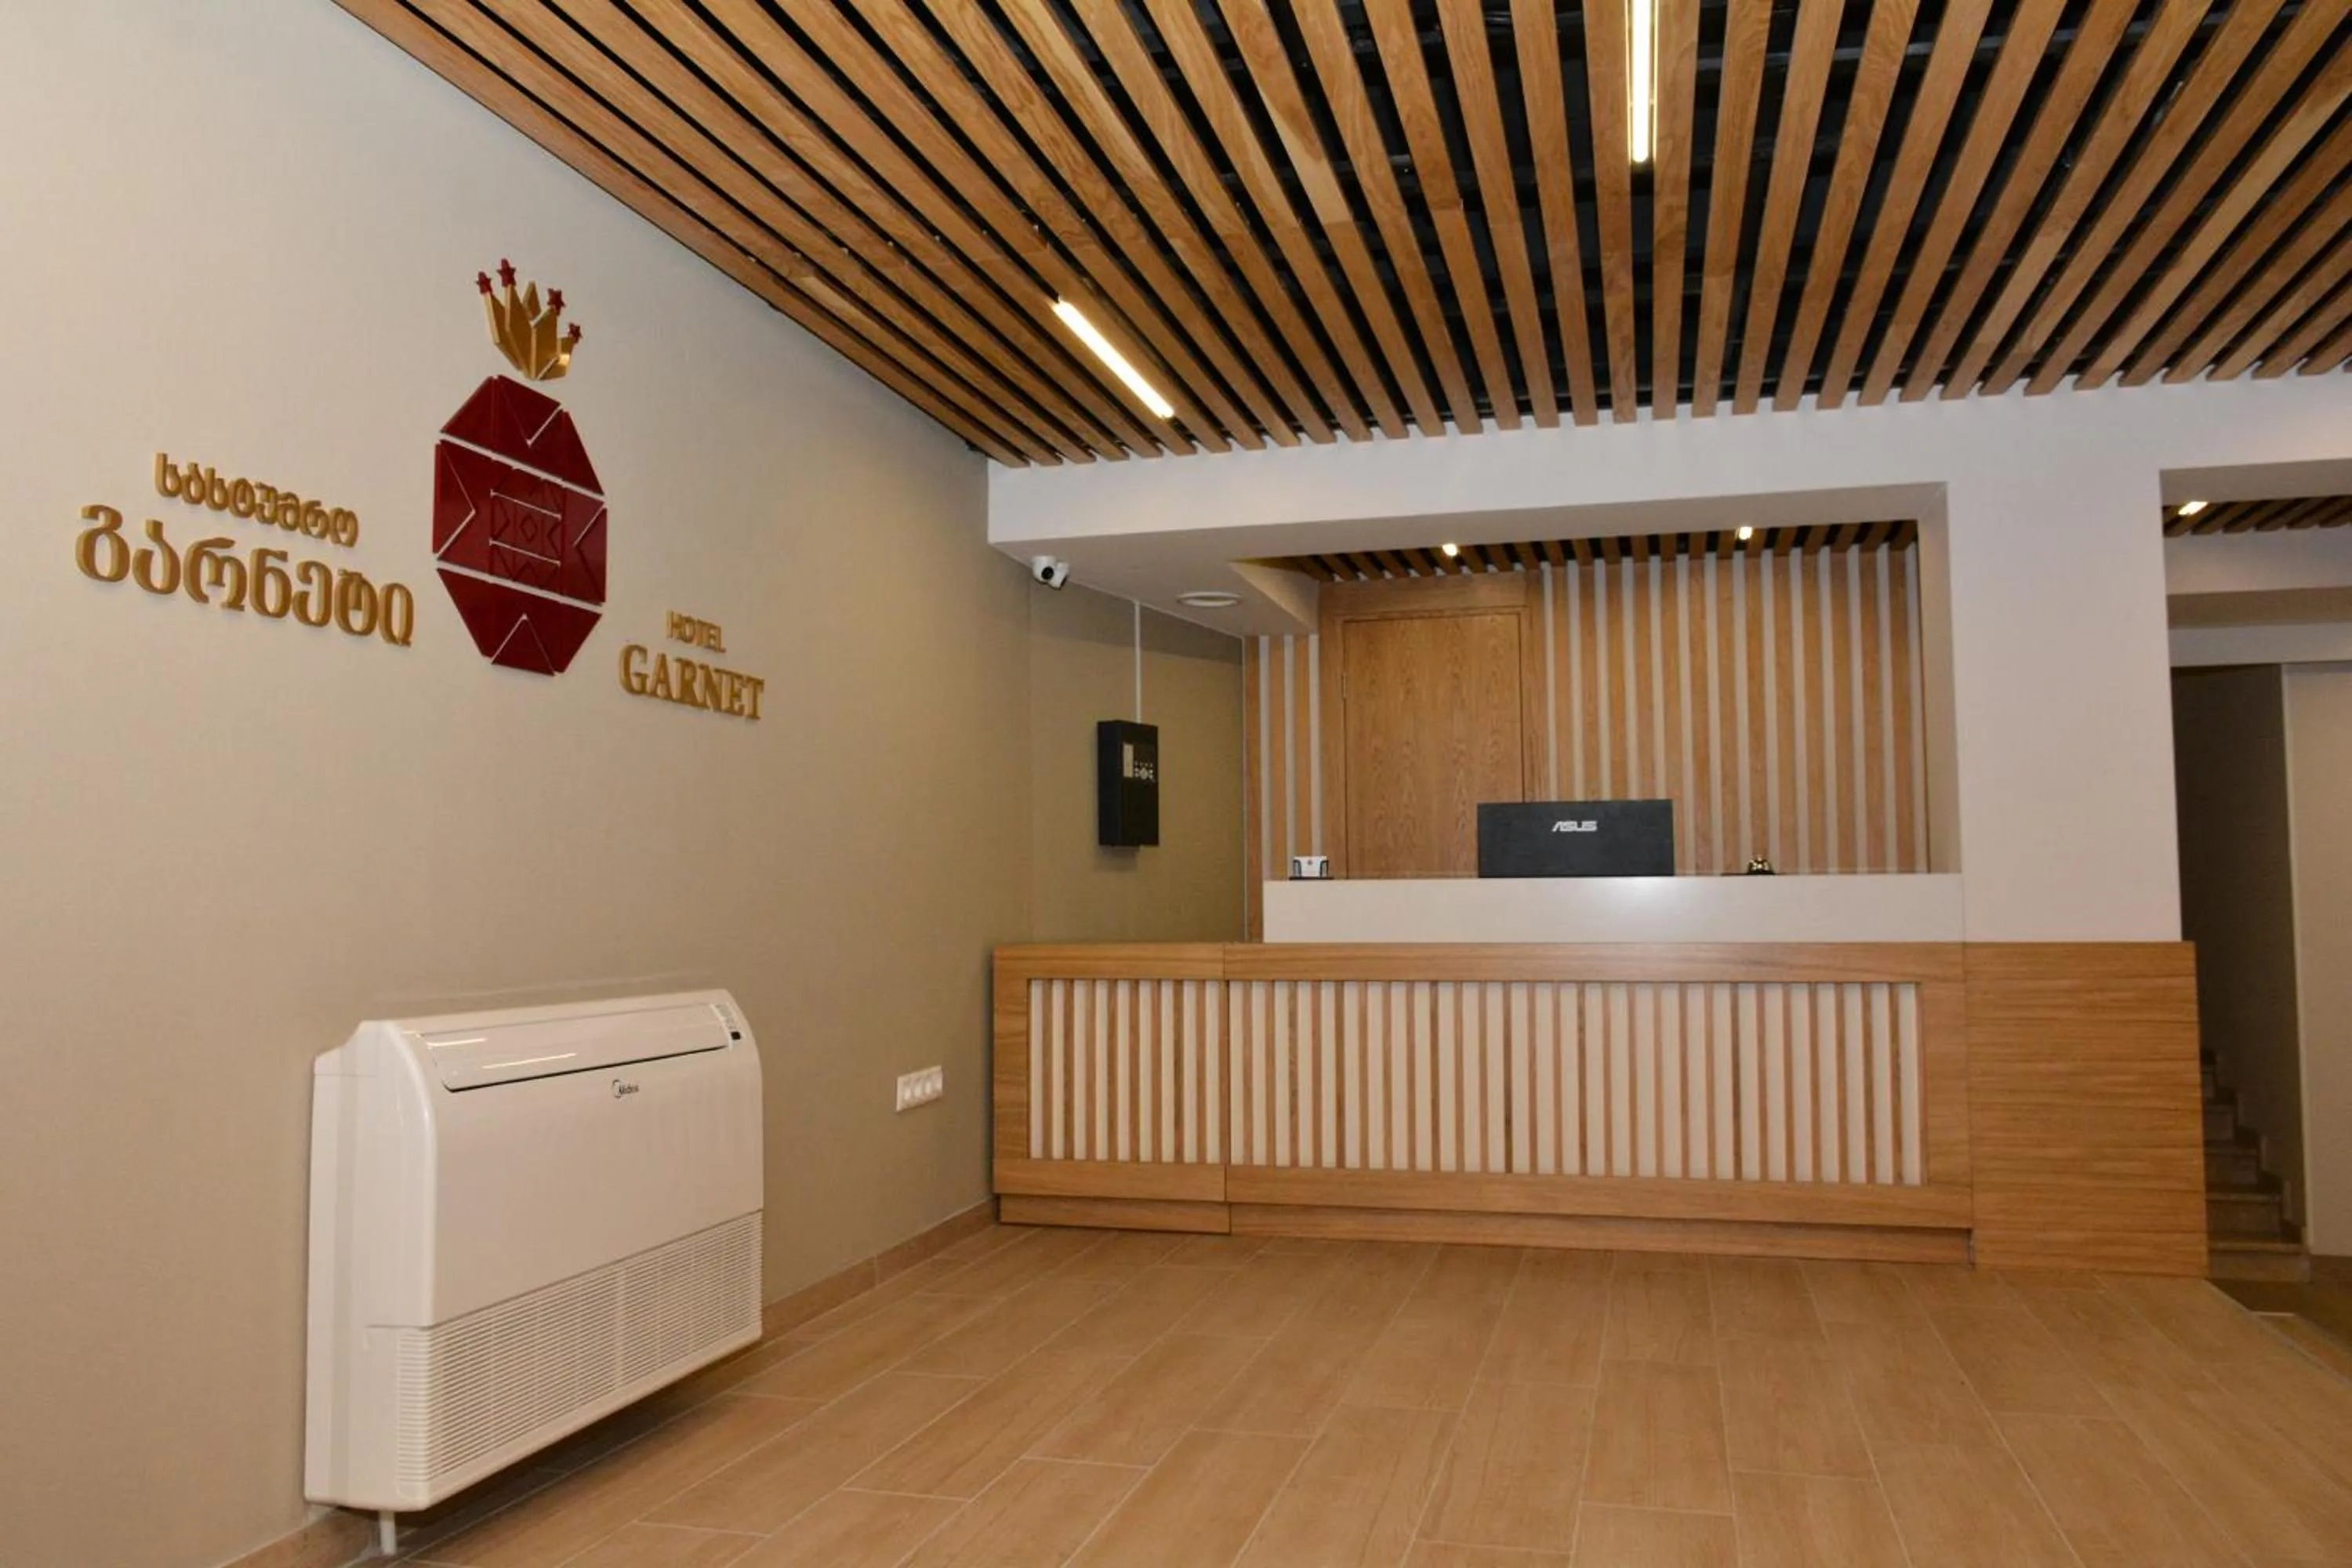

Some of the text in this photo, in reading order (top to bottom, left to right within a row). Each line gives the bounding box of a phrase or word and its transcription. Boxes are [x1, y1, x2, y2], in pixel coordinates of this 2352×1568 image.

[154, 452, 359, 547] სასტუმრო
[75, 504, 414, 647] გარნეტი
[666, 610, 726, 653] HOTEL
[619, 644, 764, 720] GARNET
[1552, 821, 1598, 832] ASUS
